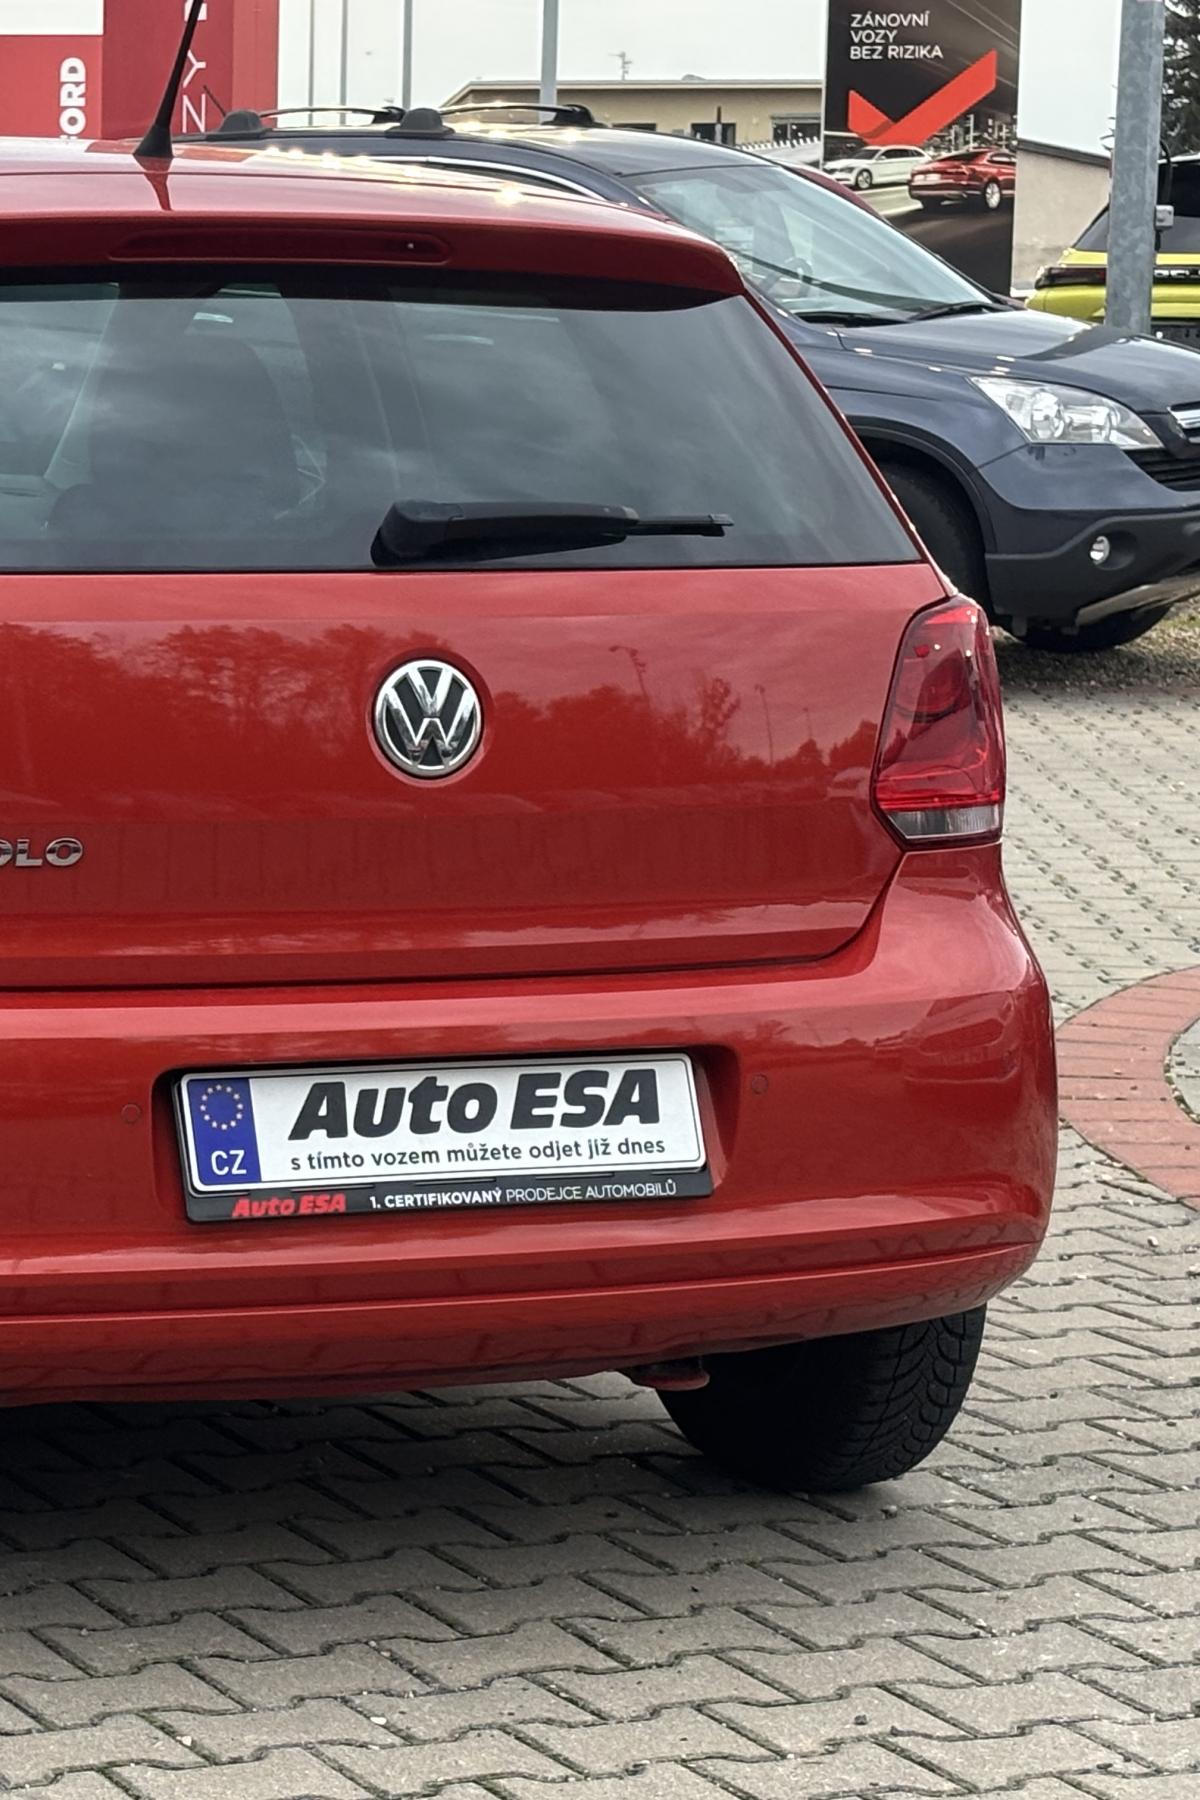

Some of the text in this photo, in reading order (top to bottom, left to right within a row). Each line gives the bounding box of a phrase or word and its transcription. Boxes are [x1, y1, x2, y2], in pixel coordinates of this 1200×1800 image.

[851, 11, 930, 28] ZÁNOVNÍ
[851, 30, 898, 44] VOZY
[850, 45, 944, 60] BEZ RIZIKA
[59, 56, 87, 140] ORD
[287, 1068, 660, 1141] Auto ESA
[211, 1150, 247, 1176] CZ
[291, 1156, 301, 1171] s
[309, 1150, 365, 1170] tímto
[371, 1150, 441, 1167] vozem
[446, 1142, 522, 1162] můžete
[529, 1140, 581, 1161] odjet
[617, 1137, 665, 1155] dnes
[231, 1192, 347, 1218] Auto ESA
[369, 1195, 382, 1210] 1.
[506, 1185, 582, 1202] PRODEJCE
[585, 1178, 677, 1199] AUTOMOBILŮ
